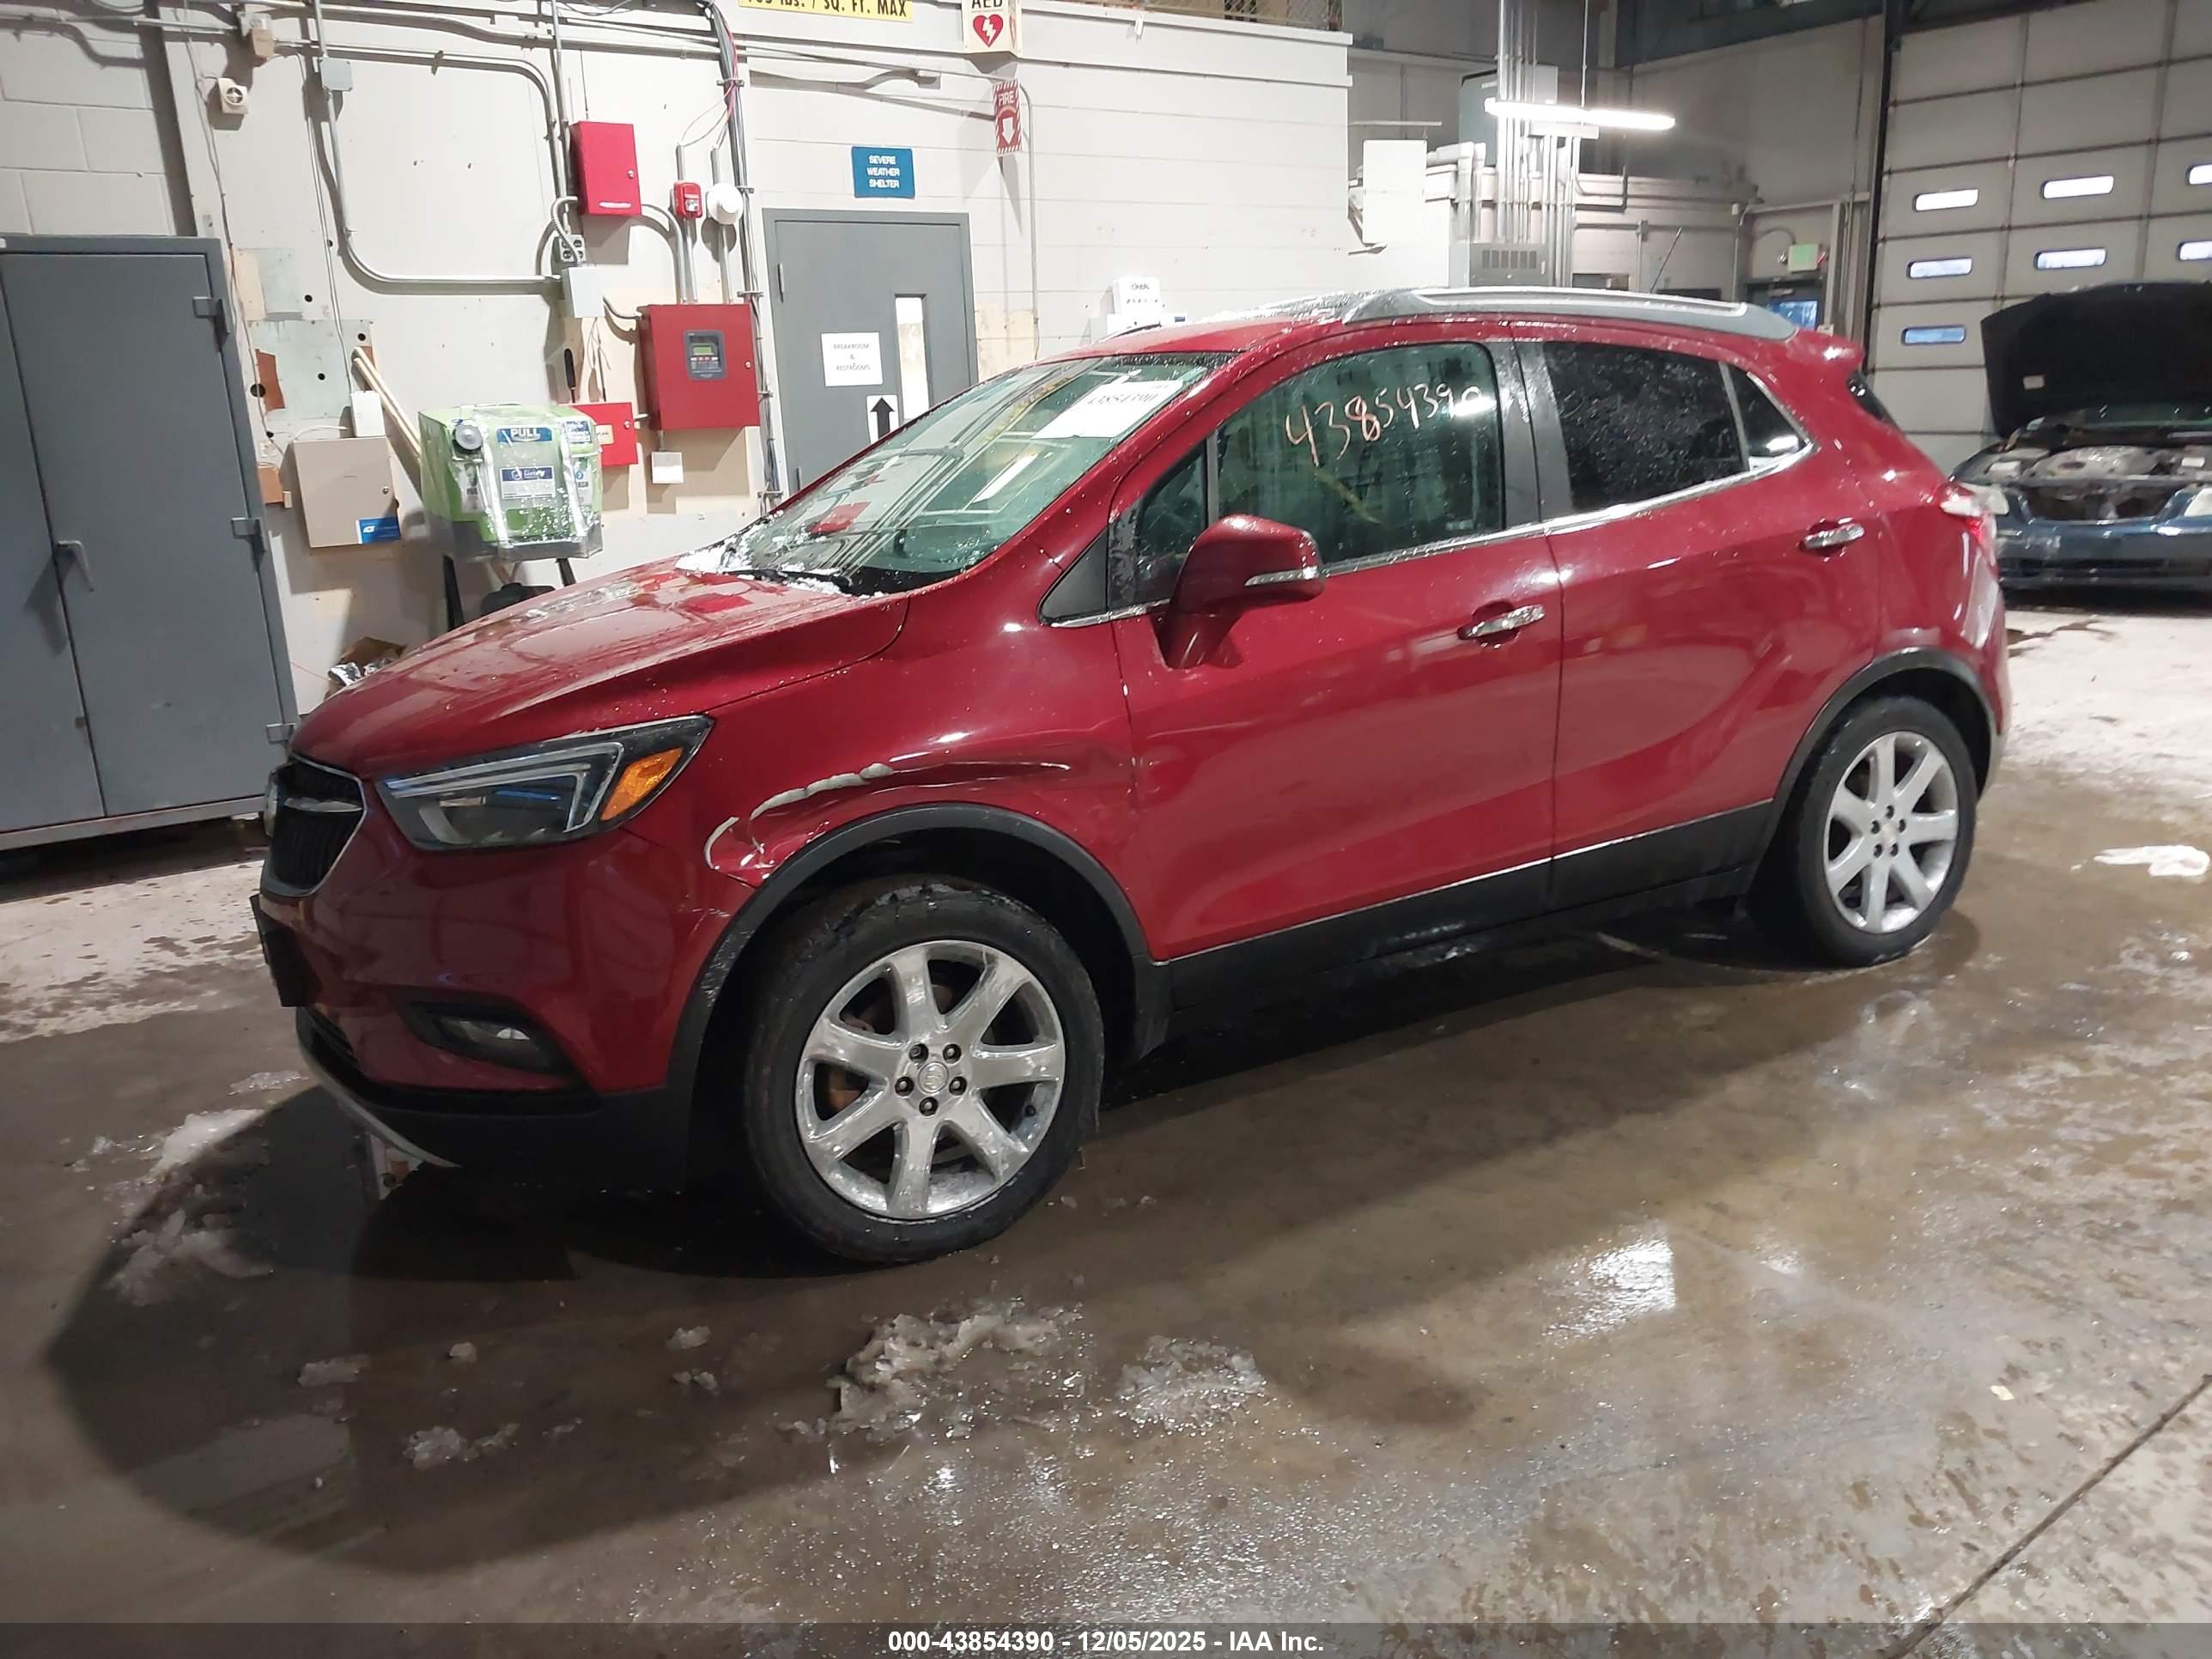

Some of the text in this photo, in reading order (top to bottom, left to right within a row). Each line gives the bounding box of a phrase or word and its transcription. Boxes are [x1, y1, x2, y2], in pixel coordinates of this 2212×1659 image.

[824, 0, 845, 12] SQ.
[877, 0, 907, 17] MAX
[971, 0, 1003, 9] AED
[999, 90, 1015, 107] FIRE
[868, 155, 896, 165] SEVERE
[866, 167, 900, 177] WEATHER
[869, 179, 900, 188] SHELTER
[1285, 383, 1484, 467] 43854390
[510, 428, 541, 437] PULL
